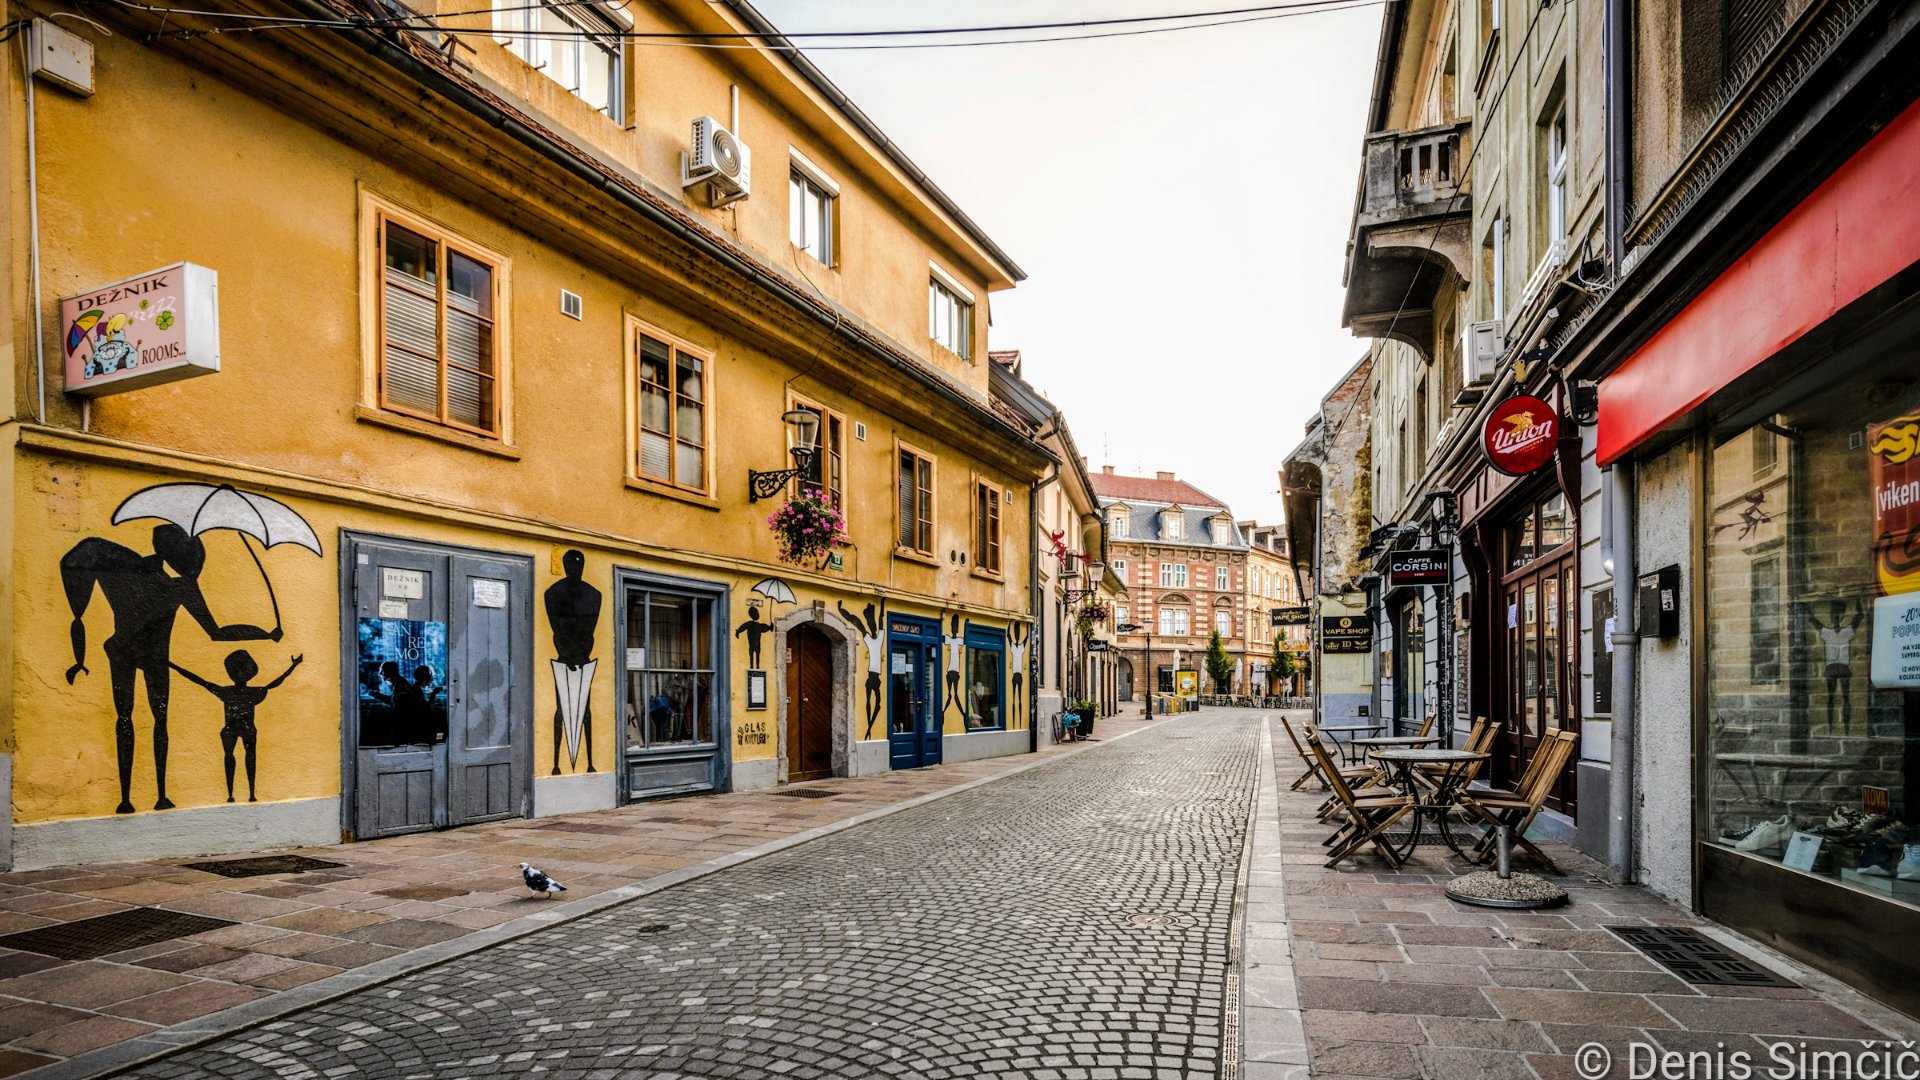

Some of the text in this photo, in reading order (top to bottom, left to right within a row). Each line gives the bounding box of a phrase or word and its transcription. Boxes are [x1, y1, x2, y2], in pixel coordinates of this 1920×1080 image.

[77, 276, 169, 312] DEŽNIK
[1491, 420, 1553, 451] Union
[1392, 562, 1448, 571] CORSINI
[1891, 623, 1920, 638] POPU
